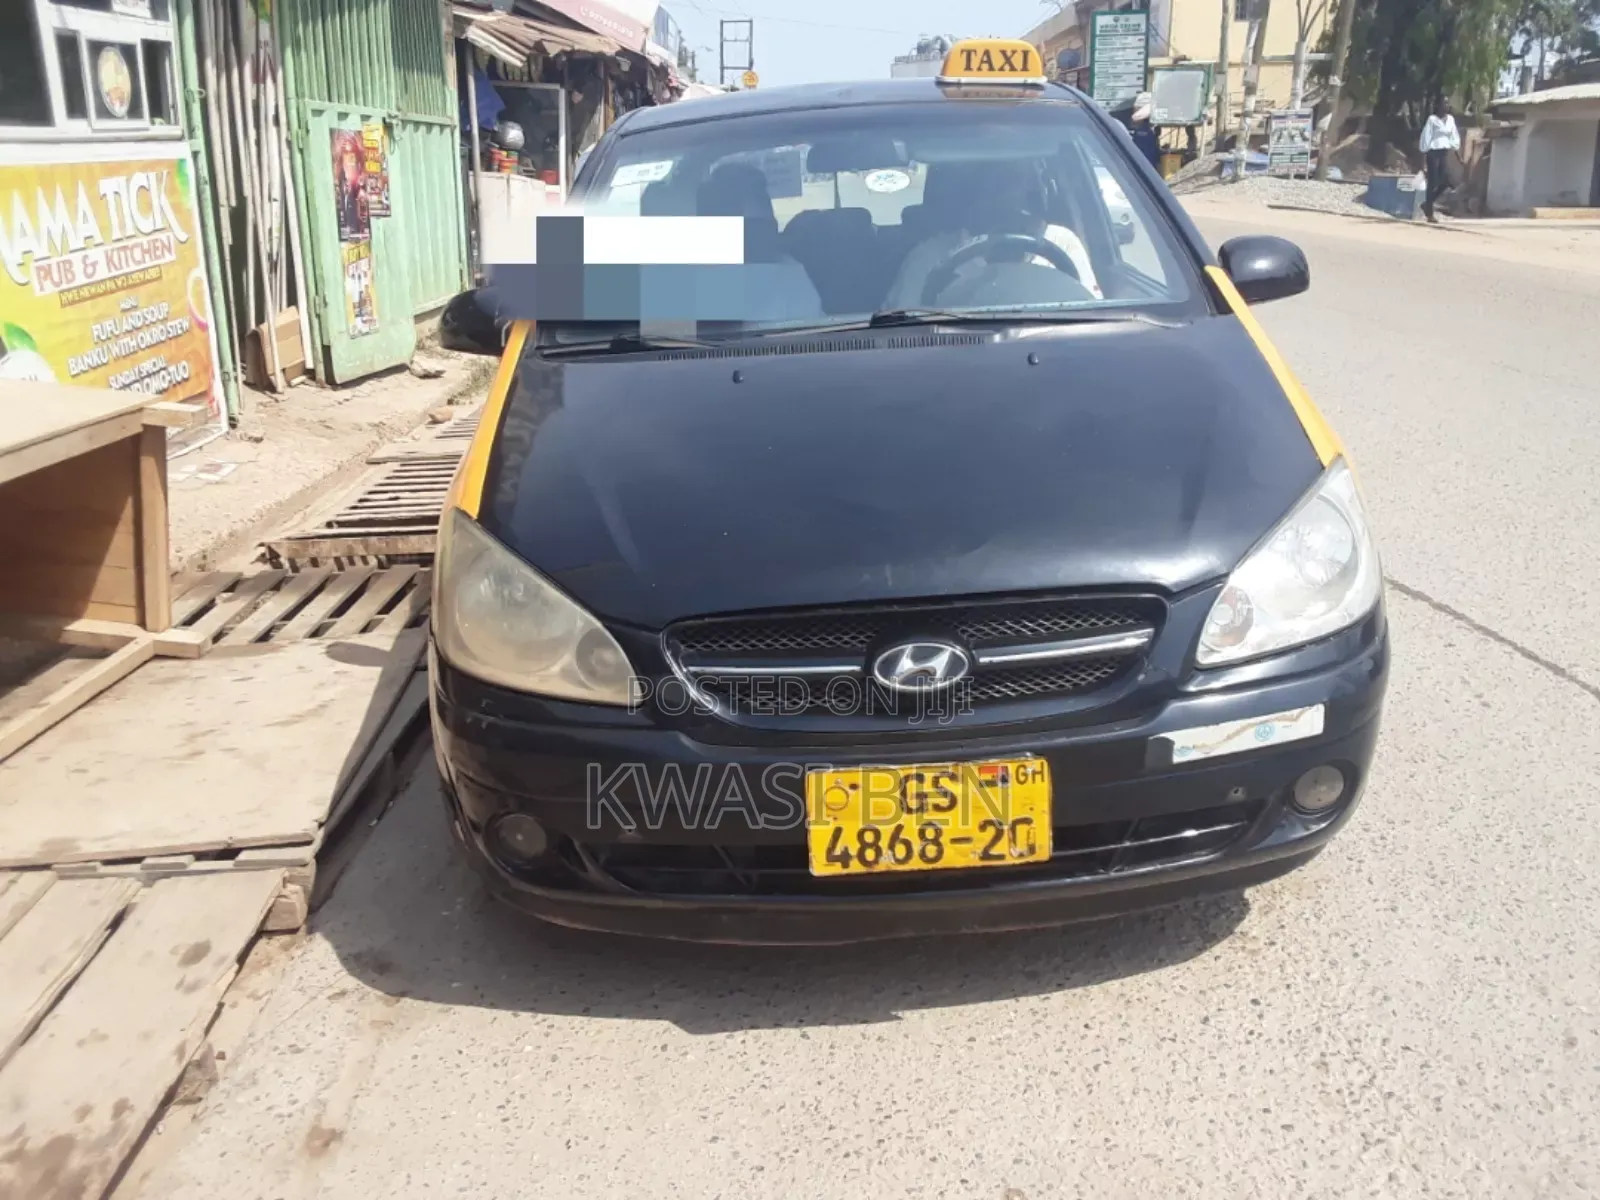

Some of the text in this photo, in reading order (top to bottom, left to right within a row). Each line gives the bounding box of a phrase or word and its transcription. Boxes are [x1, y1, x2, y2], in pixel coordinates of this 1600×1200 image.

[960, 48, 1031, 72] TAXI
[99, 170, 189, 243] TICK
[35, 258, 76, 292] PUB
[82, 254, 99, 280] &
[104, 235, 174, 274] KITCHEN
[121, 311, 143, 333] AND
[143, 302, 170, 325] SOUP
[68, 316, 190, 377] BANKU WITH OKRO STEW
[901, 763, 1046, 815] GS GH
